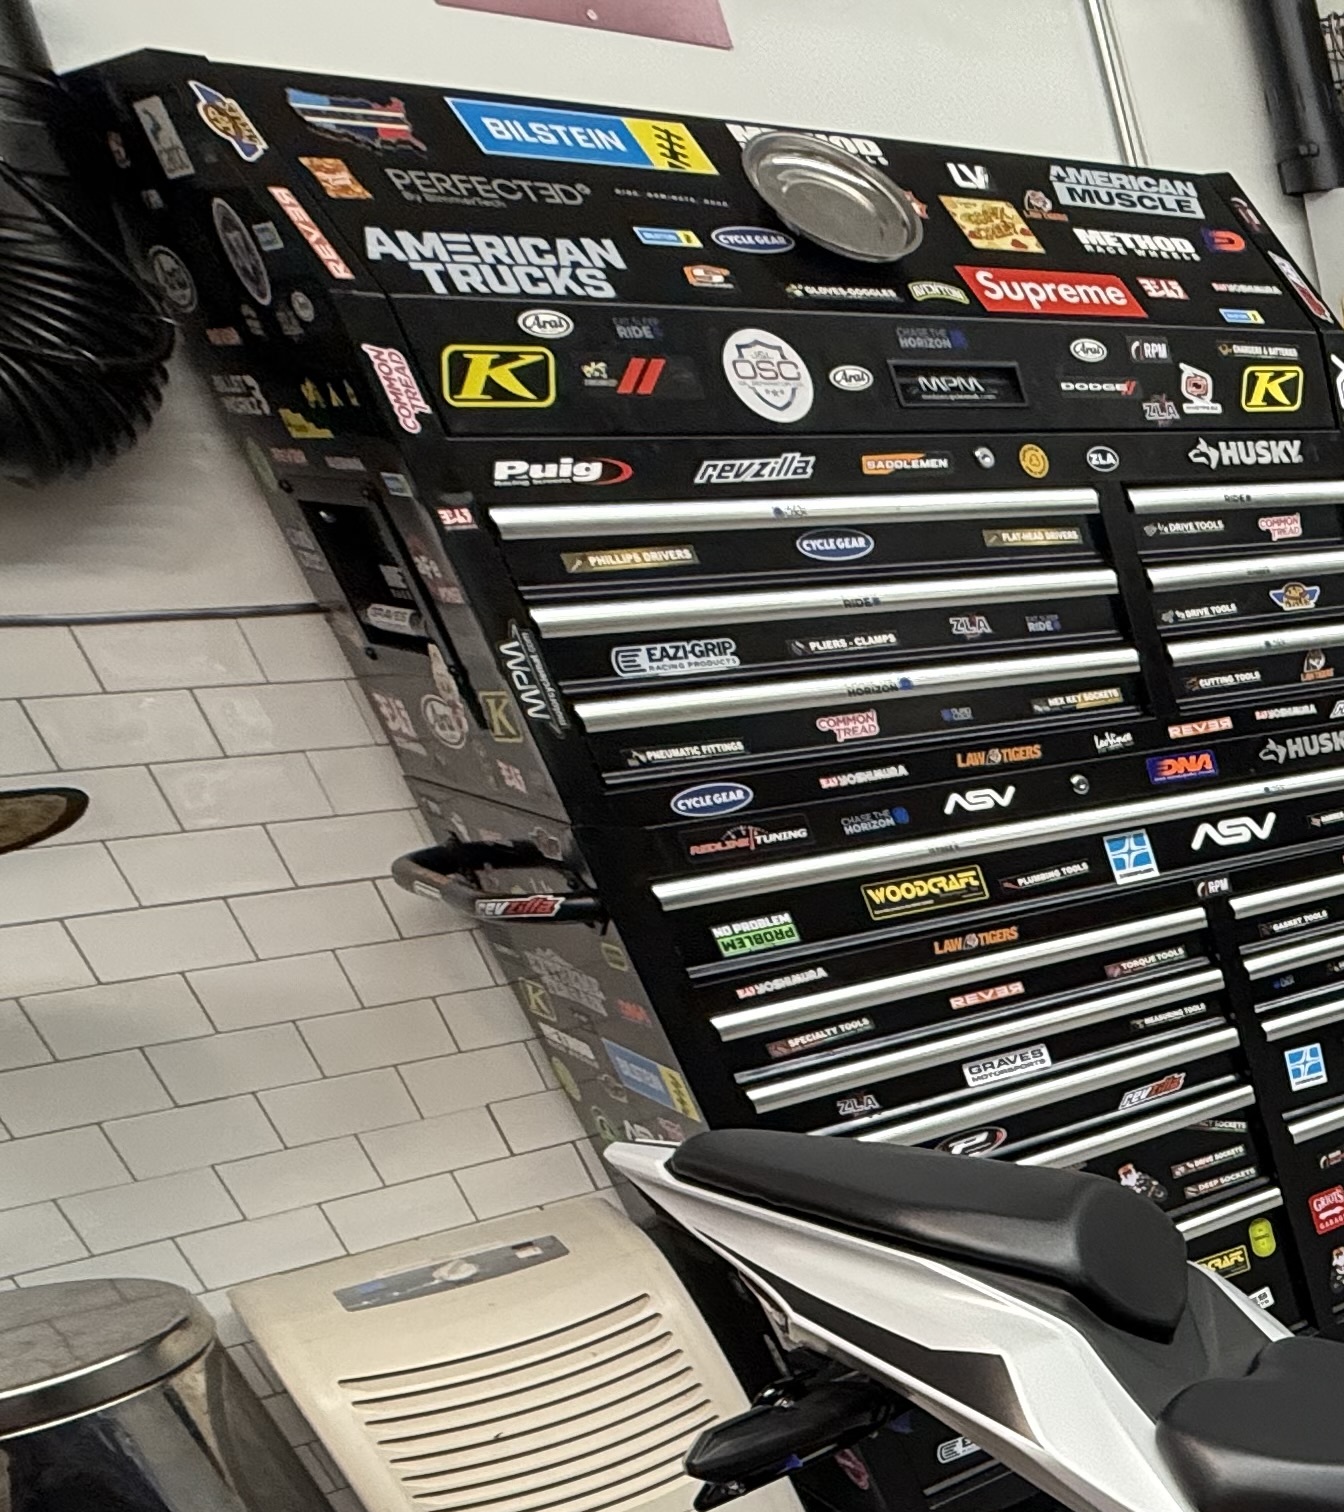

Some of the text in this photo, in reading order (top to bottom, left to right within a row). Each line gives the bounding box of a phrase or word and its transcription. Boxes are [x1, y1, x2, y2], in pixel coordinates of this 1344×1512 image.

[480, 115, 629, 153] BILSTEIN
[1050, 164, 1198, 198] AMERICAN
[1066, 185, 1196, 215] MUSCLE
[364, 226, 629, 271] AMERICAN
[719, 233, 788, 247] CYCLE GEAR
[1072, 227, 1197, 254] METHOD
[408, 260, 618, 299] TRUCKS
[975, 270, 1128, 310] Supreme
[522, 314, 568, 333] Arai
[616, 325, 655, 340] RIDE
[899, 336, 952, 350] HORIZON
[1074, 342, 1102, 357] Arai
[1142, 342, 1168, 360] RPM
[453, 352, 545, 400] K
[833, 370, 866, 385] Arai
[917, 376, 986, 392] MPM
[1060, 382, 1127, 393] DODGE
[1246, 370, 1297, 405] K
[1143, 402, 1180, 421] ZLA
[1089, 451, 1115, 466] ZLA
[1218, 439, 1303, 467] HUSKY
[493, 457, 603, 483] Puig
[697, 454, 812, 483] revzilla
[1169, 521, 1198, 533] DRIVE
[1259, 516, 1299, 528] COMMON
[802, 536, 866, 552] CYCLE GEAR
[587, 548, 693, 568] PHILLIPS DRIVERS
[949, 616, 992, 635] ZLA
[646, 641, 732, 662] EAZI-GRIP
[498, 640, 551, 722] MPM
[818, 713, 876, 731] COMMON
[833, 724, 877, 739] TREAD
[700, 740, 745, 754] FITTINGS
[956, 744, 1042, 768] LAW TIGERS
[1162, 753, 1214, 775] DNA
[677, 788, 745, 811] CYCLE GEAR
[944, 785, 1015, 815] ASV
[844, 817, 895, 836] HORIZON
[1191, 811, 1277, 851] ASV
[689, 827, 808, 856] REDLINE TUNING
[1017, 862, 1089, 887] PLUMBING TOOLS
[868, 870, 982, 906] WOODCRAFT
[476, 896, 559, 917] revzilla
[711, 912, 792, 938] NO PROBLEM
[721, 926, 796, 954] PROBLEM
[933, 926, 1019, 955] LAW TIGERS
[1120, 947, 1185, 972] TORQUE TOOLS
[950, 982, 1025, 1009] REVER
[787, 1017, 870, 1048] SPECIALTY TOOLS
[966, 1046, 1044, 1076] GRAVES
[971, 1057, 1046, 1083] MOTORSPORTS
[836, 1094, 880, 1116] ZLA
